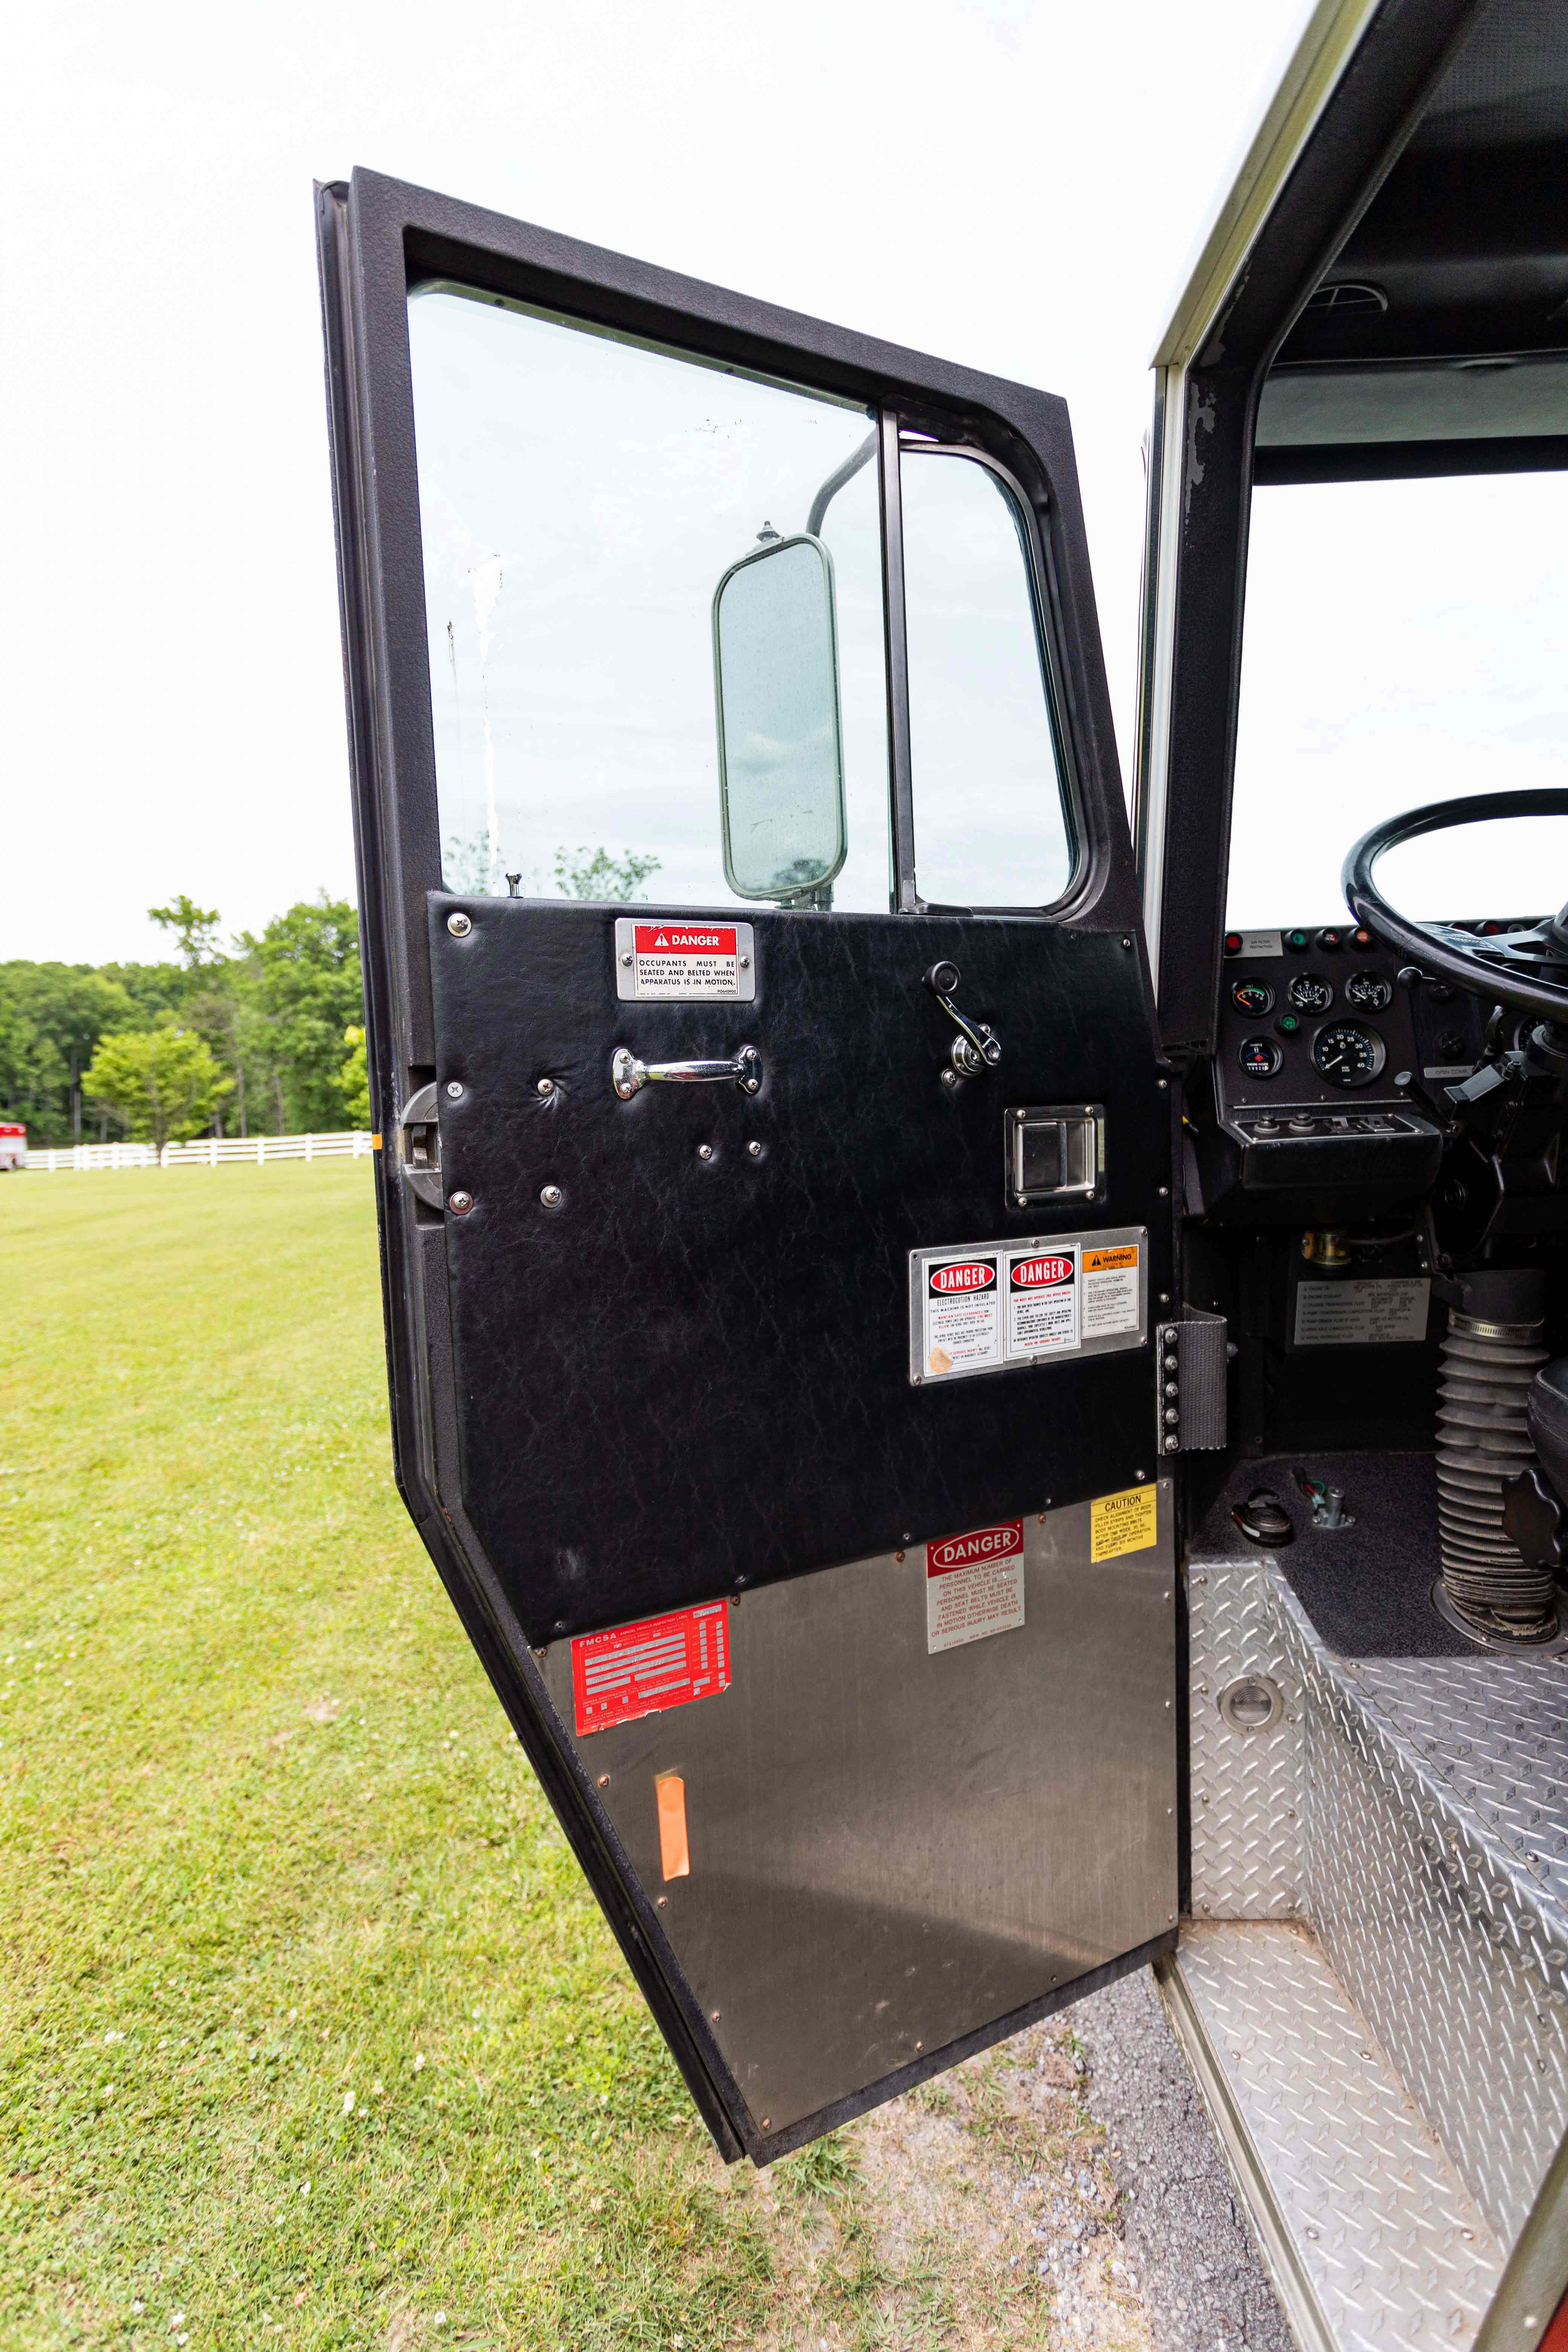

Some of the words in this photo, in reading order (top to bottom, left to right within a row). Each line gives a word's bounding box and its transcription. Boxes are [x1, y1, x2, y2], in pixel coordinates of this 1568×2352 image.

[672, 934, 720, 946] DANGER
[1102, 1254, 1132, 1262] WARNING
[940, 1267, 985, 1288] DANGER
[1020, 1260, 1064, 1282] DANGER
[937, 1295, 970, 1306] ELECTROCUTION
[1105, 1495, 1141, 1511] CAUTION
[1110, 1509, 1132, 1518] ALIGNMENT
[1107, 1522, 1129, 1530] MOUNTING
[943, 1531, 1012, 1562] DANGER
[939, 1577, 972, 1590] PERSONNEL
[992, 1565, 1015, 1575] CARRIED
[954, 1567, 980, 1578] MAXIMUM
[981, 1561, 1003, 1571] NUMBER
[936, 1593, 969, 1606] PERSONNEL
[997, 1579, 1017, 1588] SEATED
[968, 1580, 990, 1589] VEHICLE
[970, 1595, 988, 1603] BELTS
[937, 1608, 966, 1620] FASTENED
[969, 1603, 986, 1611] WHILE
[987, 1596, 1009, 1606] VEHICLE
[944, 1616, 965, 1626] MOTION
[967, 1606, 998, 1619] OTHERWISE
[1000, 1600, 1018, 1609] DEATH
[941, 1623, 965, 1634] SERIOUS
[967, 1617, 986, 1626] INJURY
[579, 1632, 617, 1647] FMCSA
